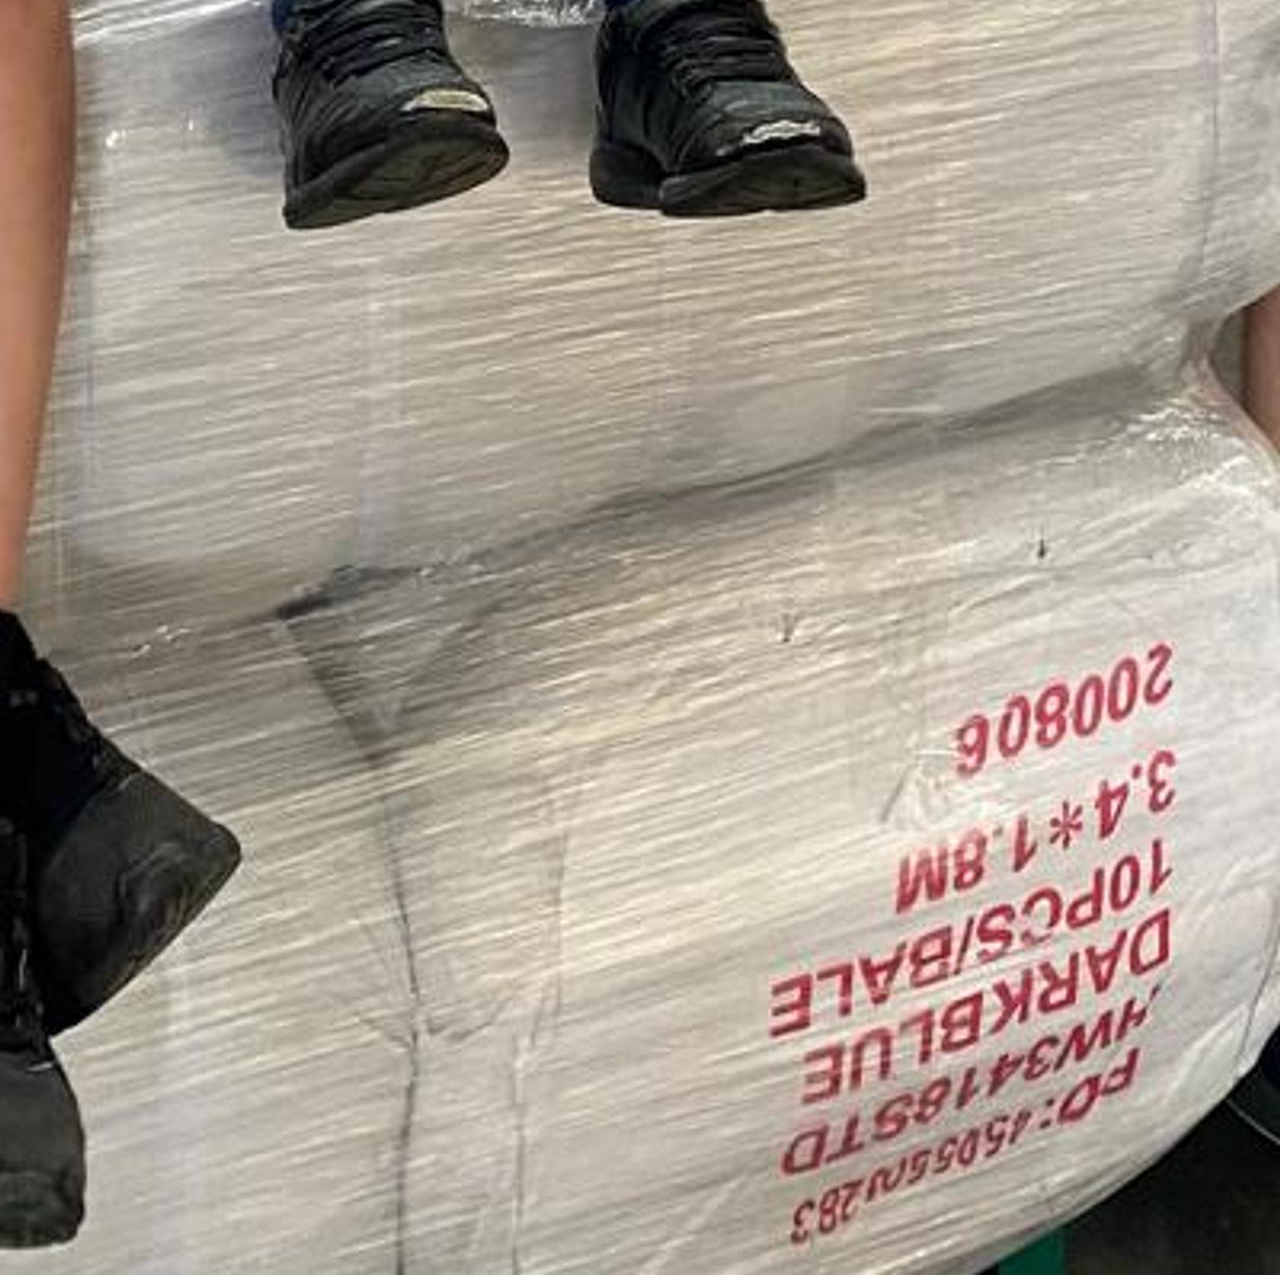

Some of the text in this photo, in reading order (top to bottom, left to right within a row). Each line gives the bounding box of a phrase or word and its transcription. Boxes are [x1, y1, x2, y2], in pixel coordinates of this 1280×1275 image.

[954, 642, 1174, 778] 200806
[768, 838, 1174, 1039] 10PCS/BALE
[781, 982, 1162, 1176] HW3418STD
